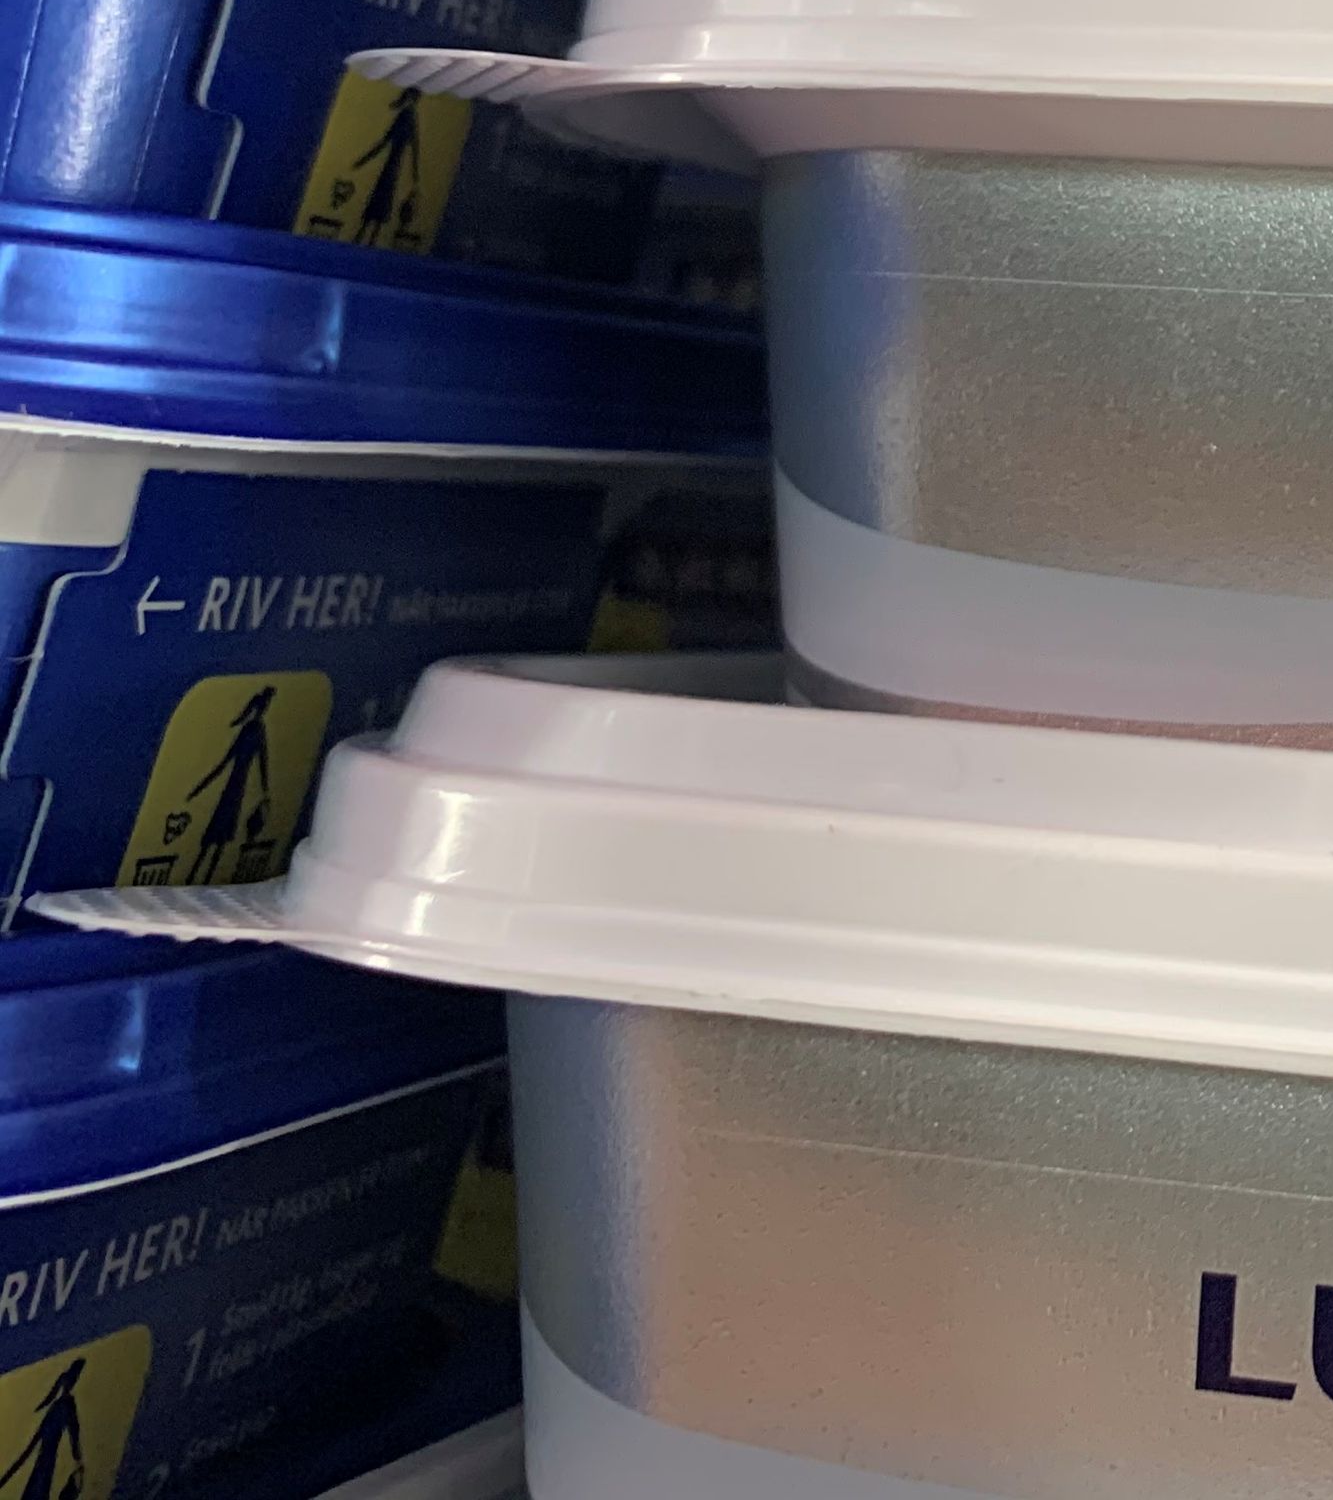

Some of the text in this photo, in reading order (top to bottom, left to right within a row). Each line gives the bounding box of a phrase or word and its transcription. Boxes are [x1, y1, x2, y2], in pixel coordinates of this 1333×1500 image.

[195, 575, 285, 633] RIV
[286, 574, 385, 629] HER!
[0, 1247, 90, 1328] RIV
[96, 1204, 210, 1298] HER!
